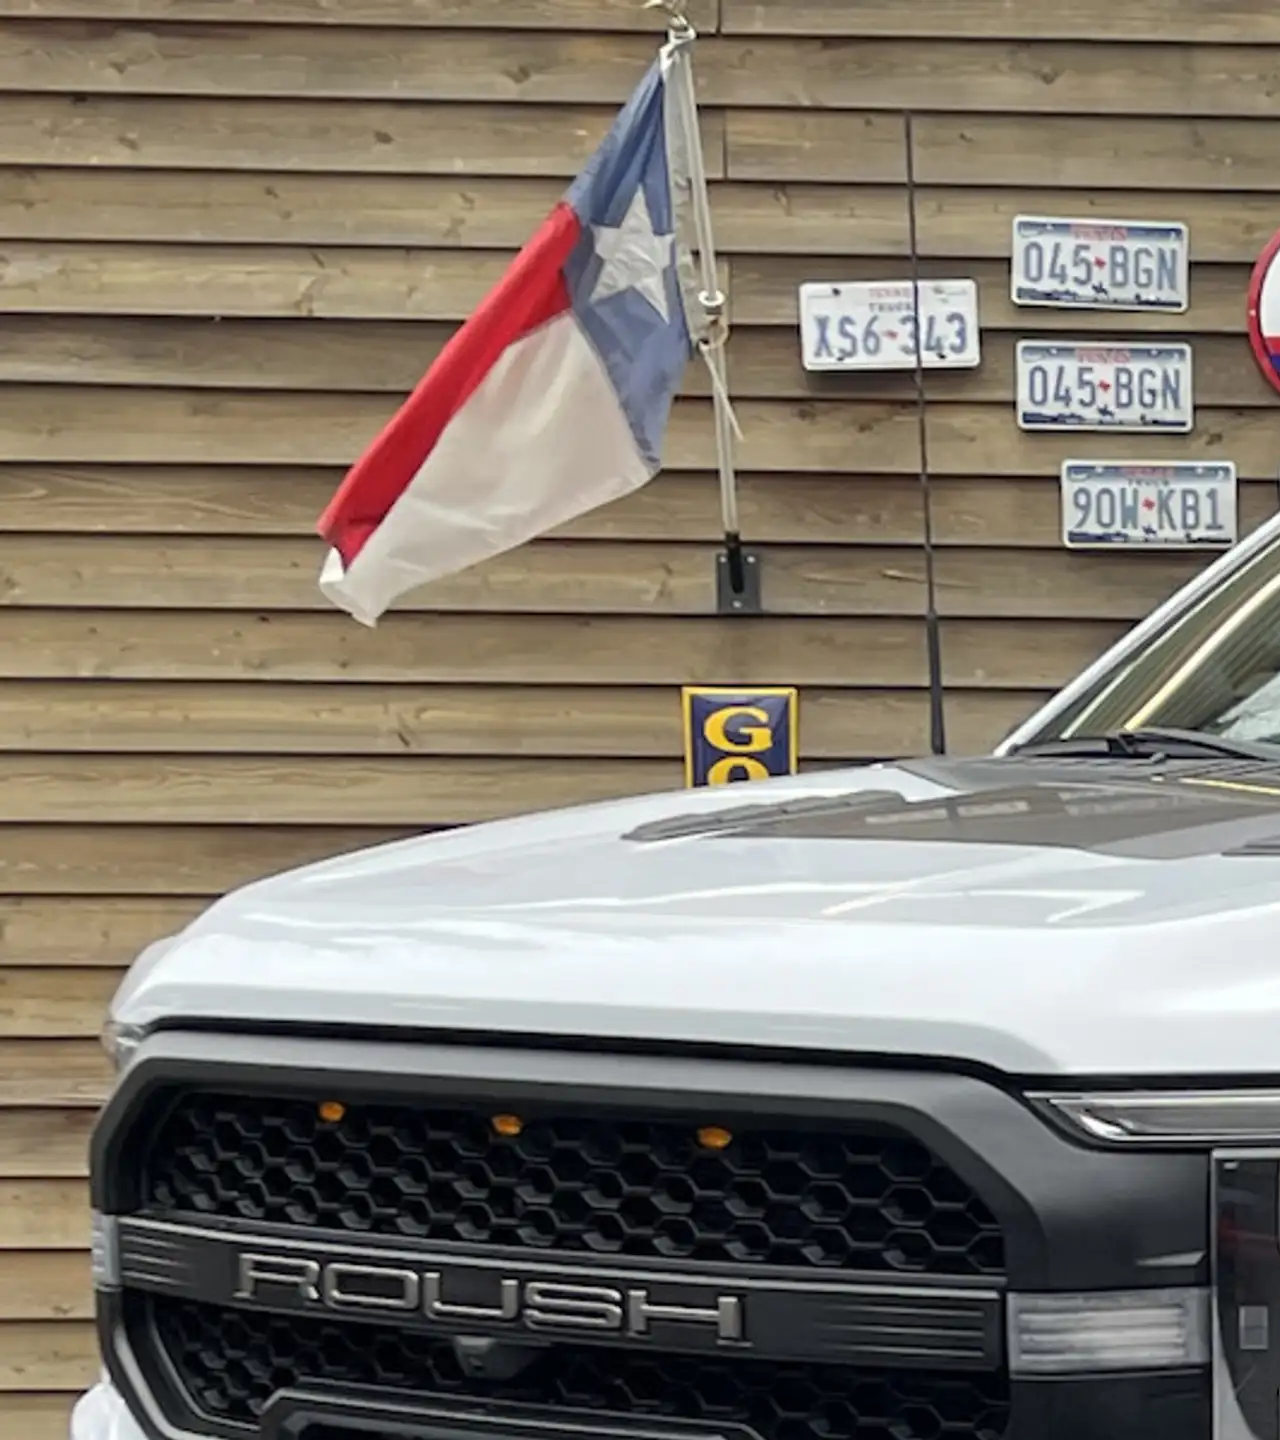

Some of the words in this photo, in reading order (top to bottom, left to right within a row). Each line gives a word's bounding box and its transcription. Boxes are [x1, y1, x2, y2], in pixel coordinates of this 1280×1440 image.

[1023, 242, 1092, 286] 045
[1109, 245, 1178, 290] BGN
[813, 315, 881, 360] XS6
[898, 311, 967, 355] 343
[1028, 365, 1096, 407] 045
[1115, 367, 1181, 410] BGN
[232, 1251, 755, 1348] ROUSH
